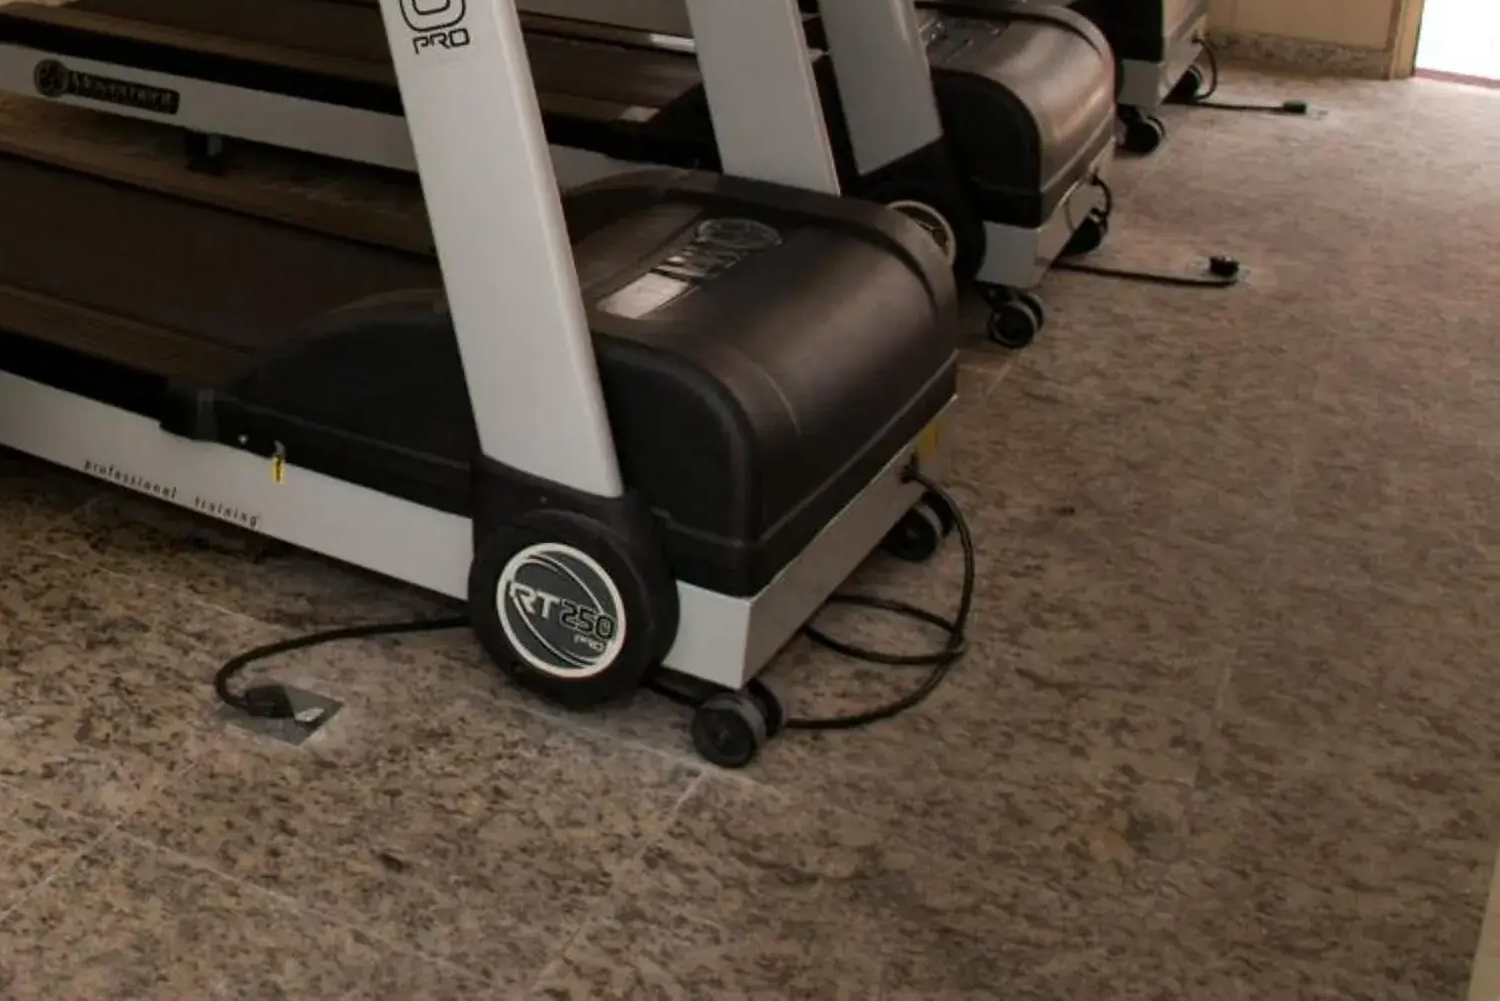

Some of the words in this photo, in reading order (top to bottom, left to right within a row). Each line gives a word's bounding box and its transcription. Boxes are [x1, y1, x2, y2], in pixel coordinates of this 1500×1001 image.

[413, 28, 470, 55] PRO
[84, 459, 178, 500] professional
[194, 496, 258, 529] training
